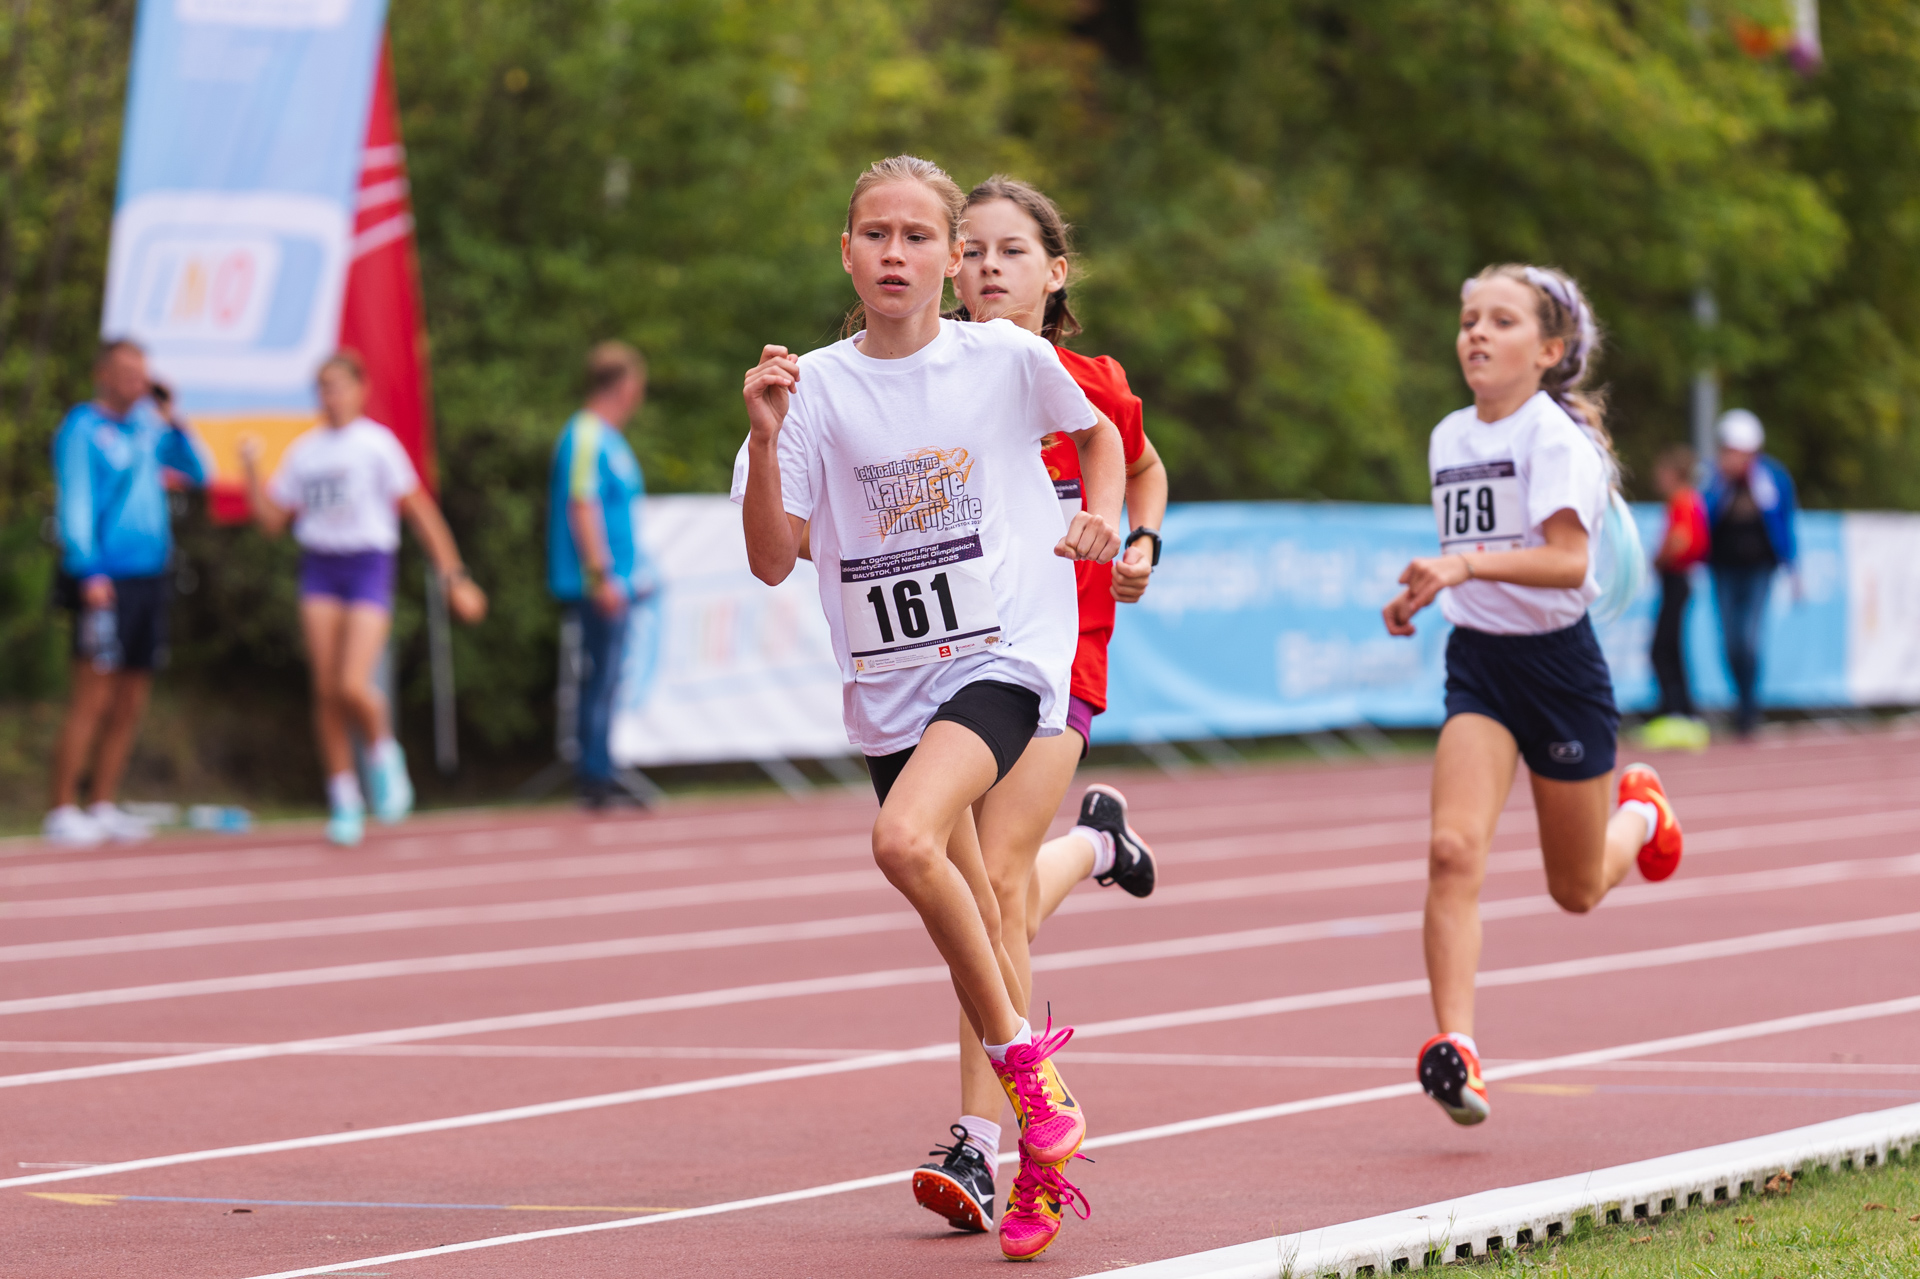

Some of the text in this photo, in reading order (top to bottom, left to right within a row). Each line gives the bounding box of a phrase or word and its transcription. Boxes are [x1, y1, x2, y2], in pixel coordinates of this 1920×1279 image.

[854, 456, 940, 481] Lekkoatletyczne
[863, 468, 965, 511] Nadzieje
[878, 495, 982, 536] Olimpijskie
[1444, 487, 1495, 537] 159
[869, 549, 919, 564] Ogólnopolski
[930, 542, 976, 557] Olimpijskich
[938, 554, 960, 563] 2025
[867, 572, 959, 644] 161
